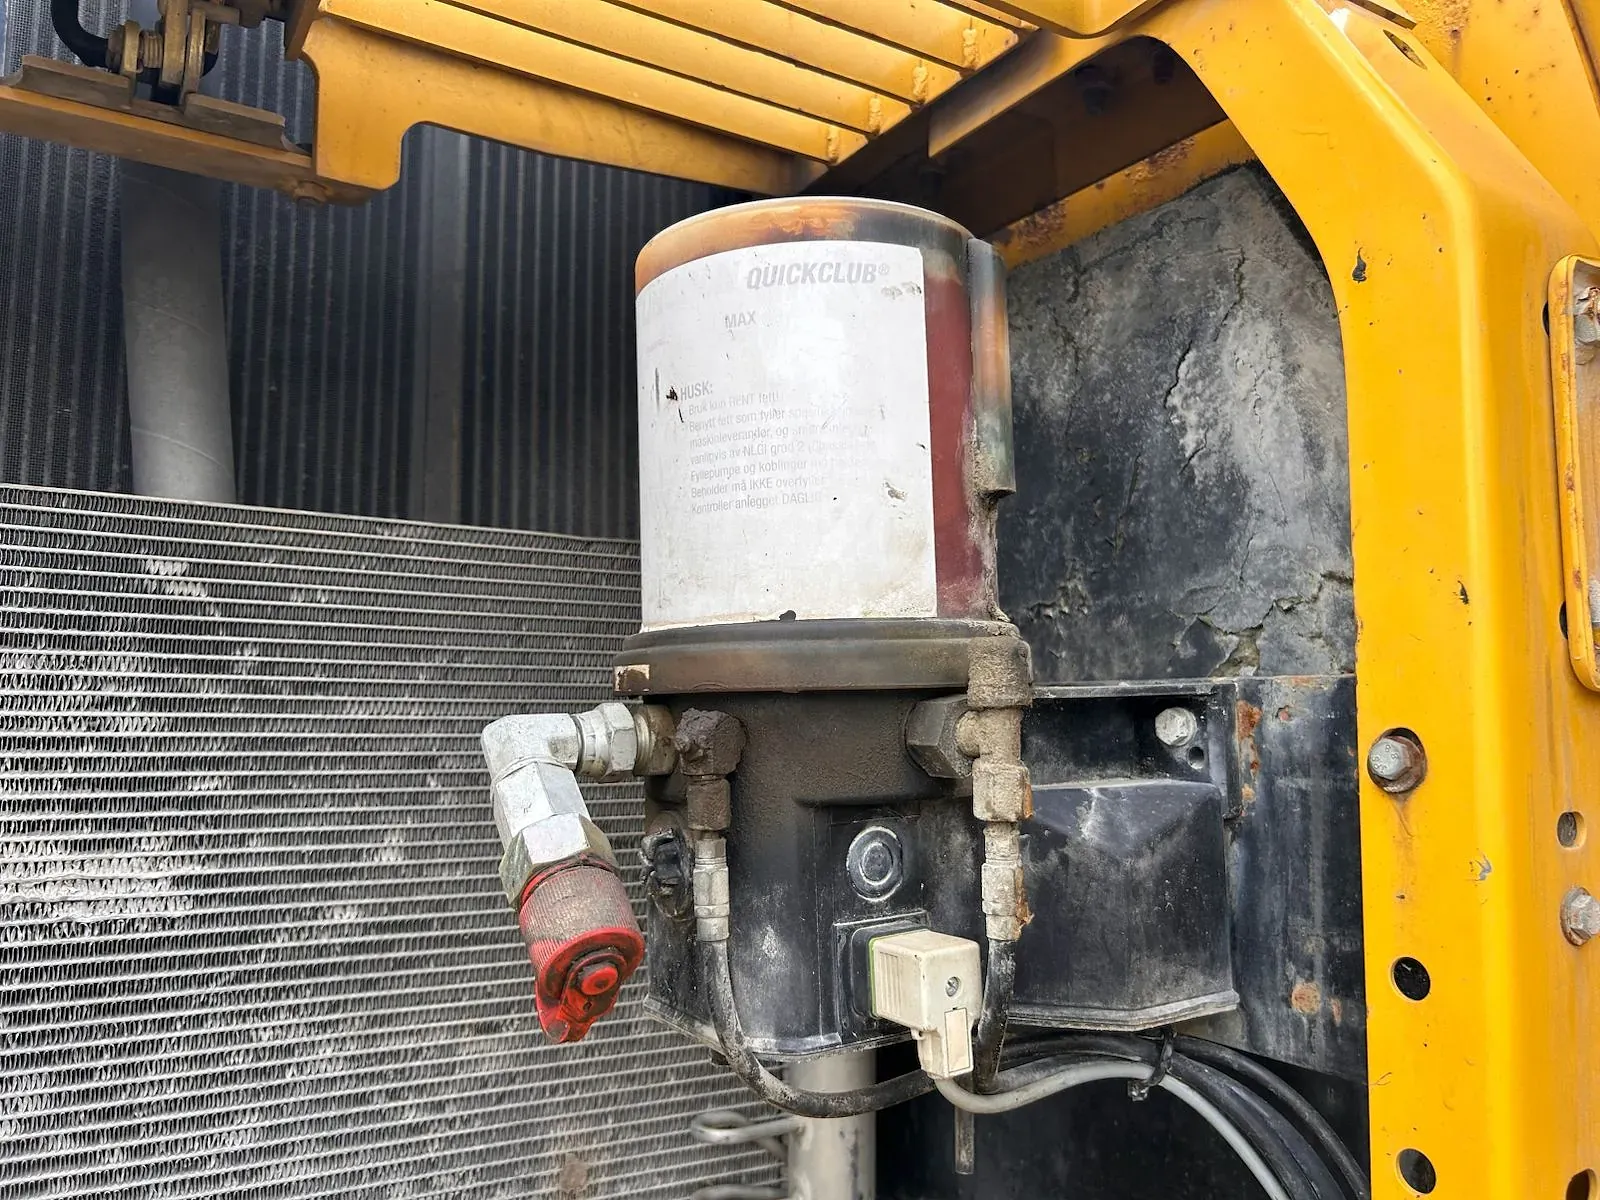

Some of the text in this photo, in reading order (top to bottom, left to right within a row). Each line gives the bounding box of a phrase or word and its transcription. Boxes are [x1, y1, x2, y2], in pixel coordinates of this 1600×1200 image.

[724, 310, 756, 328] MAX
[680, 380, 714, 402] HUSK:
[688, 399, 709, 416] Bruk
[728, 393, 755, 407] RENT
[688, 417, 716, 432] Benytt
[735, 412, 757, 424] som
[775, 426, 789, 439] og
[728, 447, 742, 459] av
[743, 463, 756, 476] og
[691, 482, 729, 499] Beholder
[730, 479, 748, 493] må
[749, 476, 774, 491] IKKE
[691, 499, 734, 515] Kontroller
[734, 493, 779, 510] anlegget
